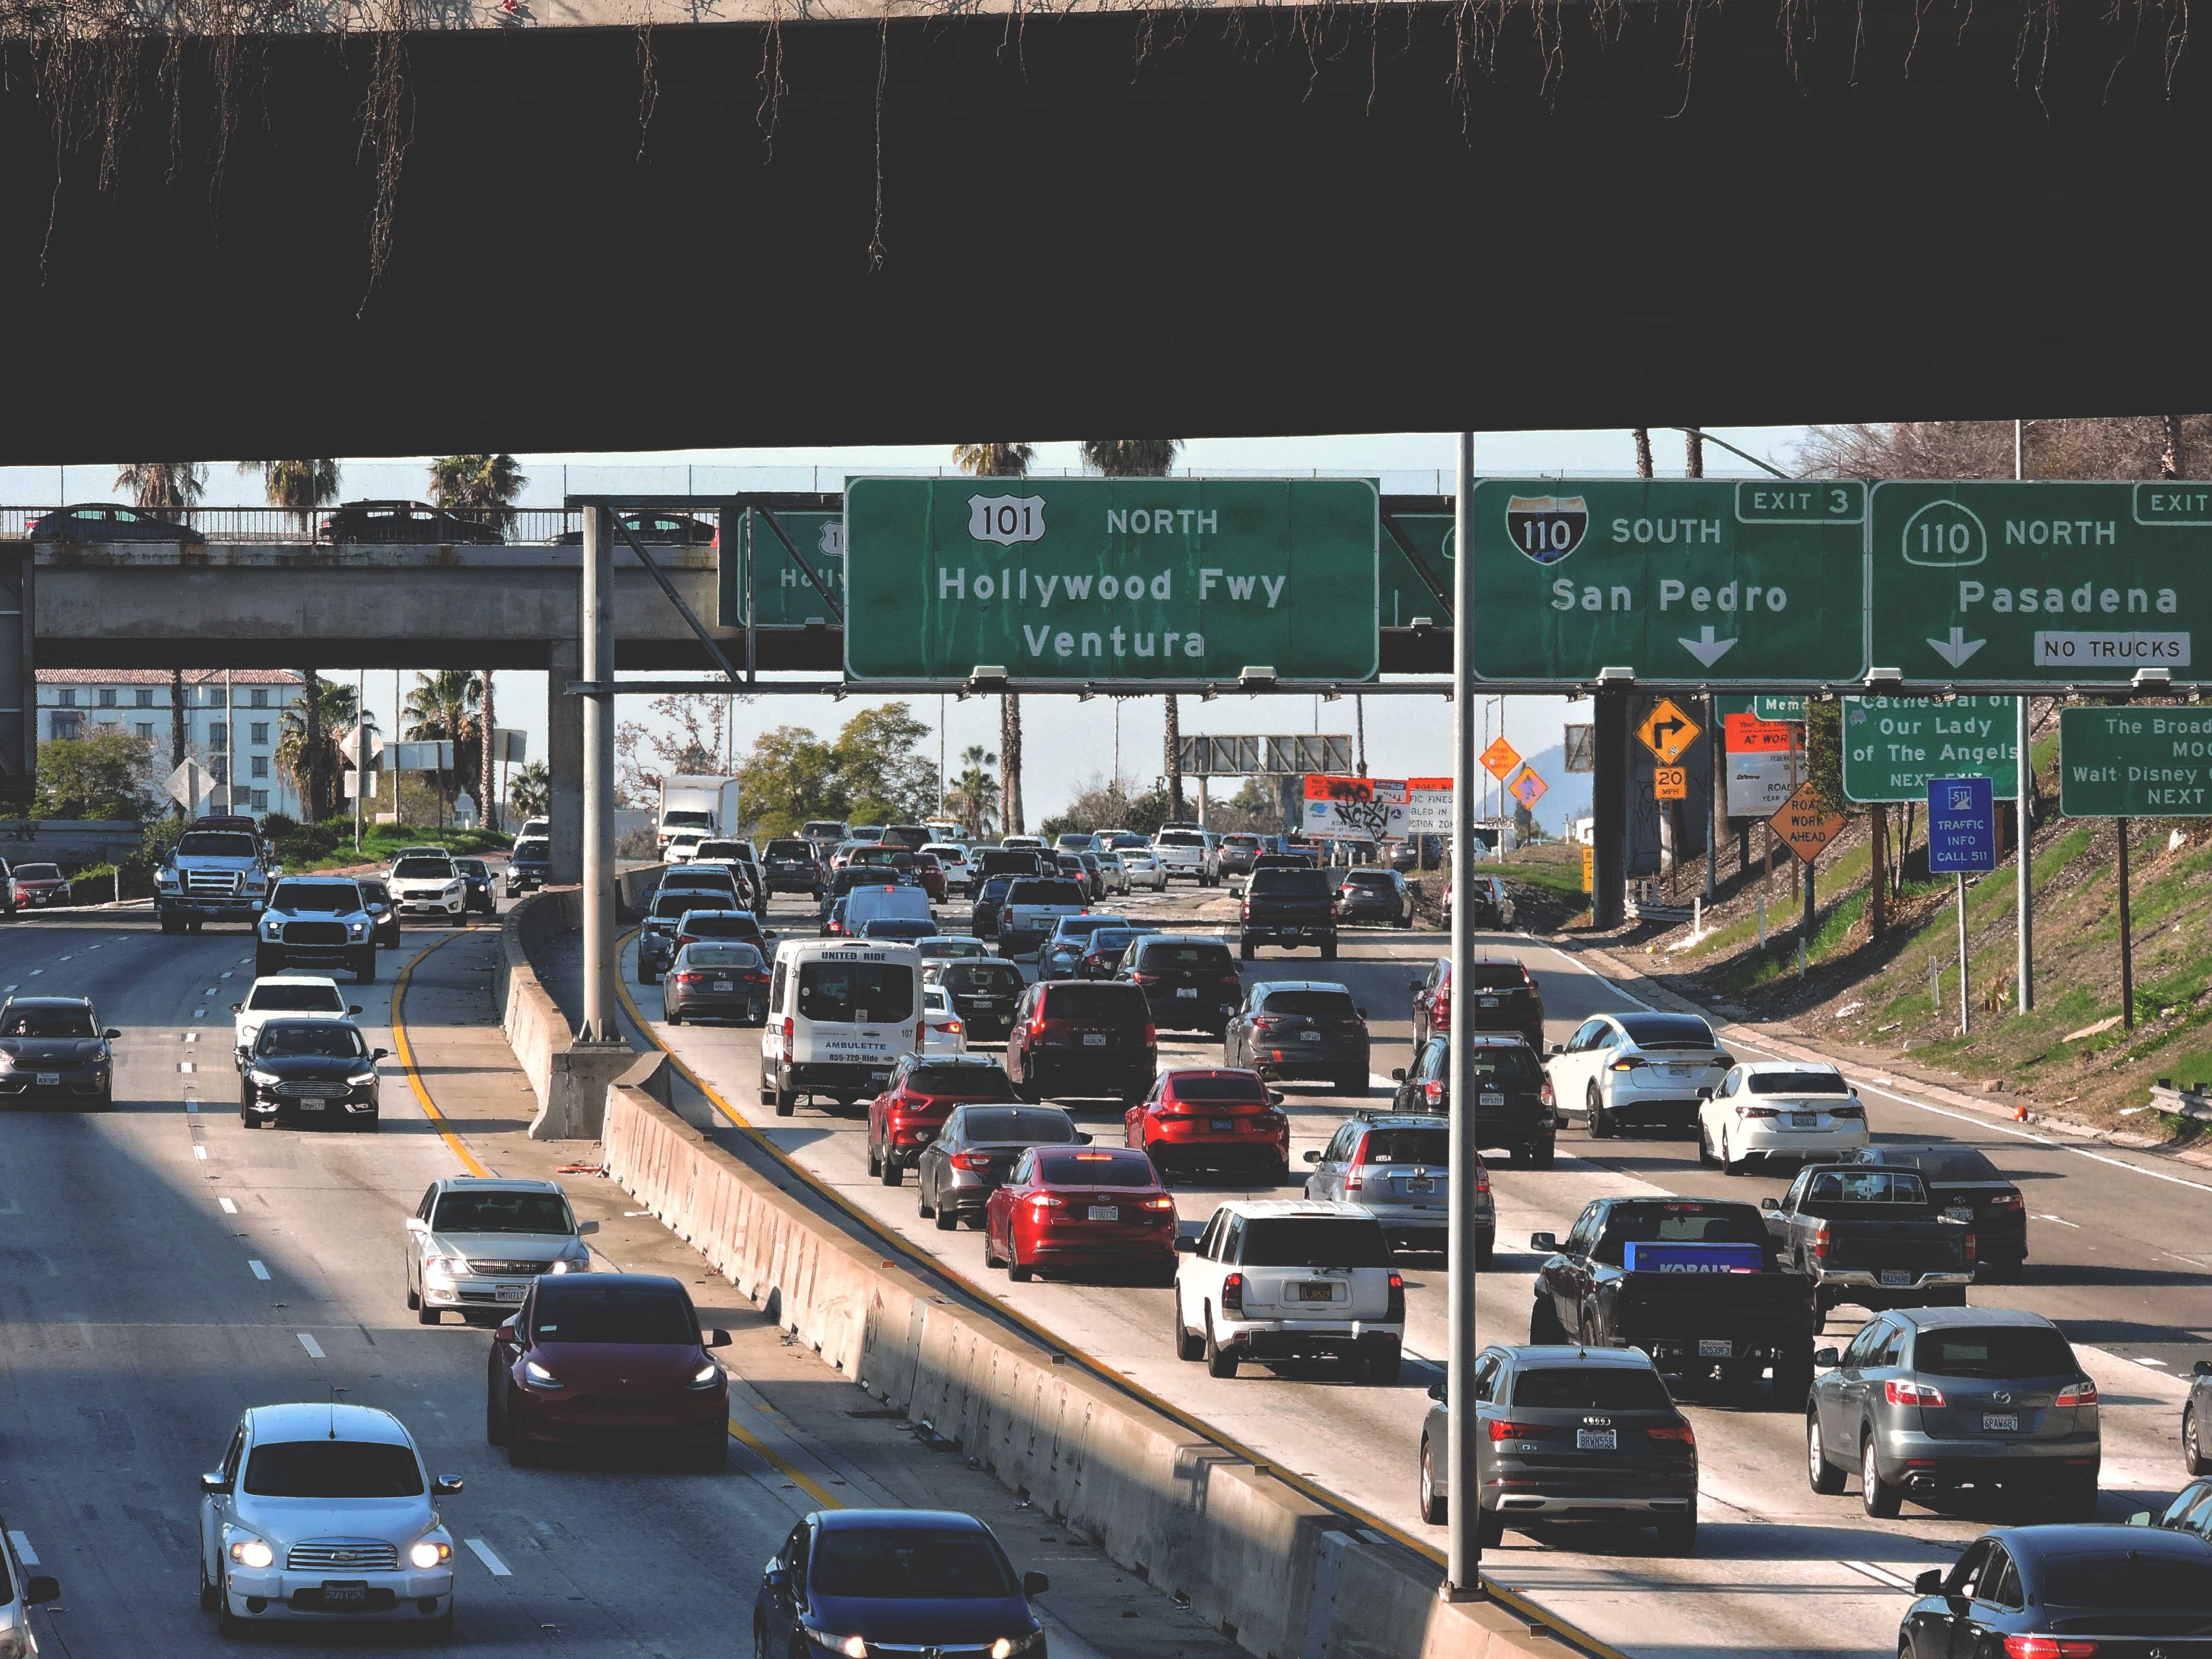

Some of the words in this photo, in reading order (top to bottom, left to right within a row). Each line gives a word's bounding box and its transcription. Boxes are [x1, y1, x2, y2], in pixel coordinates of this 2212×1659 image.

[1753, 492, 1811, 510] EXIT
[1829, 490, 1849, 514] 3
[2151, 495, 2208, 511] EXIT
[981, 505, 1034, 536] 101
[1107, 509, 1218, 535] NORTH
[1524, 521, 1571, 549] 110
[1611, 519, 1721, 543] SOUTH
[1920, 523, 1970, 554] 110
[2005, 522, 2115, 545] NORTH
[938, 568, 1172, 608] Hollywood
[1200, 568, 1286, 608] Fwy
[1550, 580, 1632, 613] San
[1660, 580, 1788, 613] Pedro
[1960, 581, 2177, 613] Pasadena
[1023, 625, 1205, 658] Ventura
[2045, 641, 2076, 658] NO
[2089, 641, 2181, 658] TRUCKS
[1880, 718, 1921, 735] Our
[1936, 717, 1992, 737] Lady
[2106, 719, 2142, 734] The
[2153, 719, 2212, 734] Broad
[1744, 735, 1757, 745] AT
[1763, 734, 1789, 744] WOR
[1854, 745, 1874, 762] of
[1887, 744, 1926, 761] The
[1940, 743, 2018, 765] Angels
[1658, 771, 1683, 785] 20
[2073, 766, 2117, 782] Walt
[2128, 766, 2197, 785] Disney
[1428, 795, 1453, 804] FINES
[1954, 791, 1968, 802] 511
[2148, 789, 2205, 804] NEXT
[1409, 820, 1433, 828] CTION
[1791, 816, 1824, 827] WORK
[1937, 820, 1984, 830] TRAFFIC
[1790, 832, 1826, 842] AHEAD
[1948, 836, 1976, 846] INFO
[1937, 852, 1967, 862] CALL
[1971, 852, 1987, 861] 511
[821, 951, 857, 960] UNITED
[863, 953, 886, 961] RIDE
[901, 1029, 913, 1038] 107
[825, 1042, 886, 1050] AMBULETTE
[829, 1054, 879, 1063] 855-720-Ride
[1984, 1418, 2017, 1428] 6PAW687
[1581, 1436, 1613, 1447] 8RWN558
